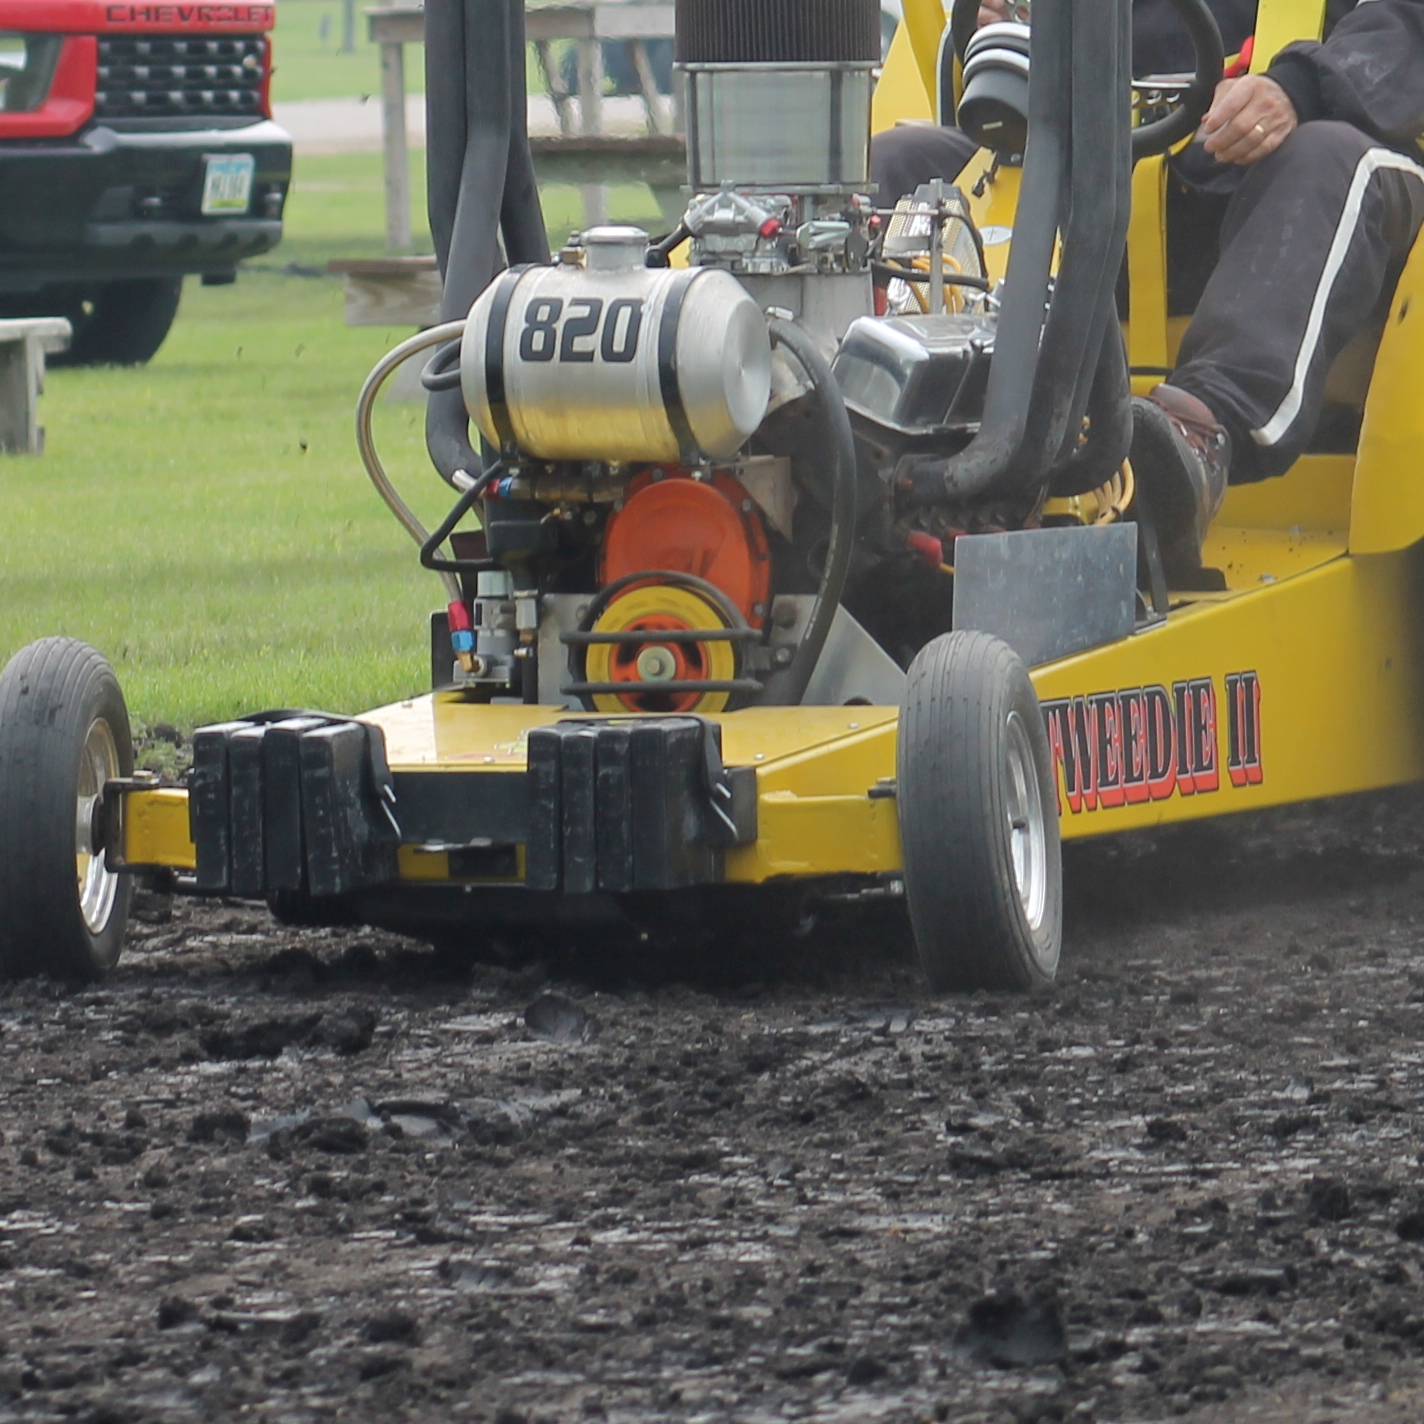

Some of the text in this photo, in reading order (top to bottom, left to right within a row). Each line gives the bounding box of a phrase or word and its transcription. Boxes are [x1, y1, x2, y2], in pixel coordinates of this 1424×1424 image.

[105, 5, 272, 23] CHEVROLET
[519, 297, 645, 363] 820
[1039, 670, 1264, 817] WEEDIE II
